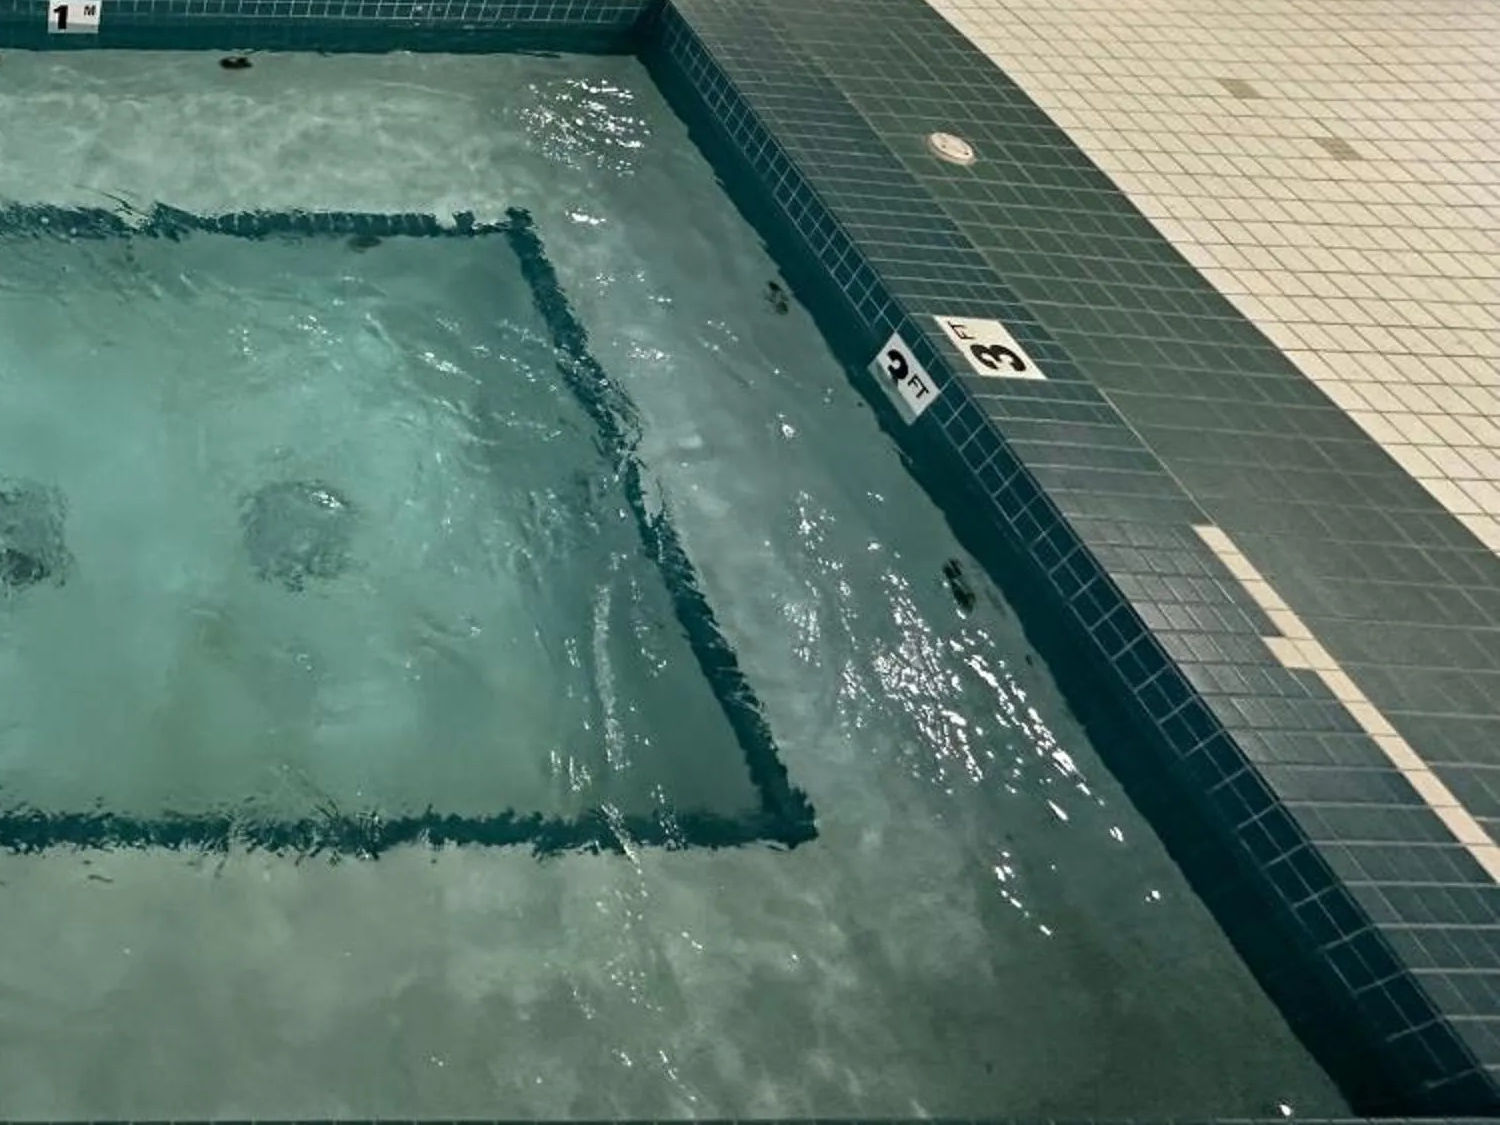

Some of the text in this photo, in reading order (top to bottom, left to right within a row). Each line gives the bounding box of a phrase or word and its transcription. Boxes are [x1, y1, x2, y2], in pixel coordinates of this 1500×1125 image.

[53, 5, 69, 30] 1
[947, 320, 1027, 372] 3 FT
[907, 373, 930, 399] FT
